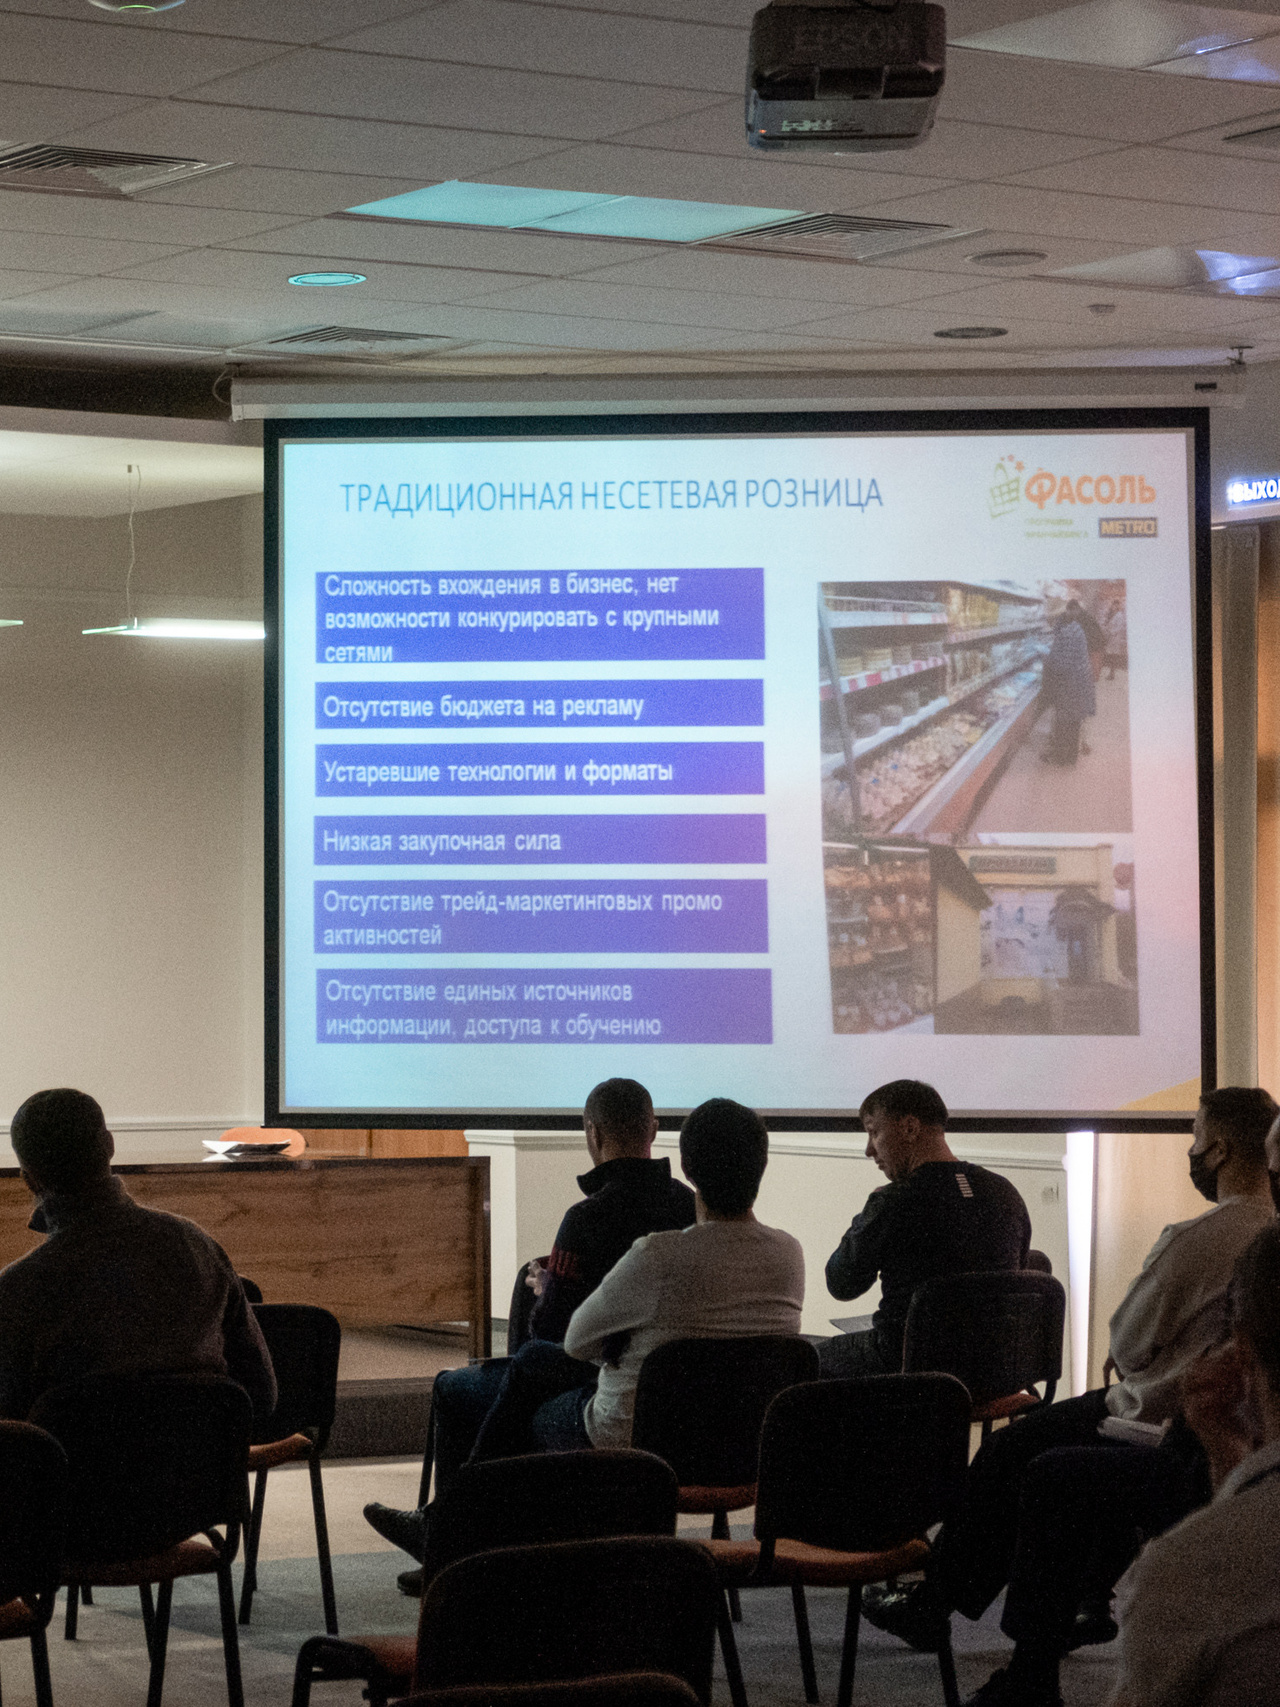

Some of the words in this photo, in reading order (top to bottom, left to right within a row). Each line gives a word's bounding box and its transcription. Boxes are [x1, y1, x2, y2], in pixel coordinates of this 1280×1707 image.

[341, 482, 573, 518] ТРАДИЦИОННАЯ
[582, 480, 736, 510] НЕСЕТЕВАЯ
[747, 477, 883, 513] РОЗНИЦА
[1025, 468, 1157, 510] ФАСОЛЬ
[1232, 479, 1280, 502] ВЫХО
[1101, 521, 1155, 536] METRO
[325, 574, 431, 598] Сложность
[439, 577, 541, 598] вхождения
[550, 577, 560, 594] в
[567, 571, 638, 597] бизнес,
[647, 575, 679, 593] нет
[325, 611, 450, 629] возможности
[458, 610, 598, 632] конкурировать
[606, 609, 617, 626] с
[623, 608, 719, 632] крупными
[325, 644, 393, 662] сетями
[324, 697, 433, 722] Отсутствие
[441, 695, 525, 719] бюджета
[533, 699, 556, 716] на
[562, 698, 644, 721] рекламу
[324, 761, 440, 787] Устаревшие
[448, 763, 557, 782] технологии
[565, 763, 576, 780] и
[583, 760, 673, 787] форматы
[324, 830, 392, 852] Низкая
[399, 832, 506, 857] закупочная
[515, 833, 562, 851] сила
[324, 890, 434, 916] Отсутствие
[442, 887, 653, 916] трейд-маркетинговых
[662, 893, 723, 915] промо
[324, 923, 442, 946] активностей
[326, 980, 436, 1005] Отсутствие
[444, 983, 516, 1003] единых
[524, 983, 633, 1002] источников
[326, 1014, 455, 1040] информации,
[464, 1018, 542, 1040] доступа
[551, 1018, 560, 1034] к
[566, 1013, 662, 1040] обучению
